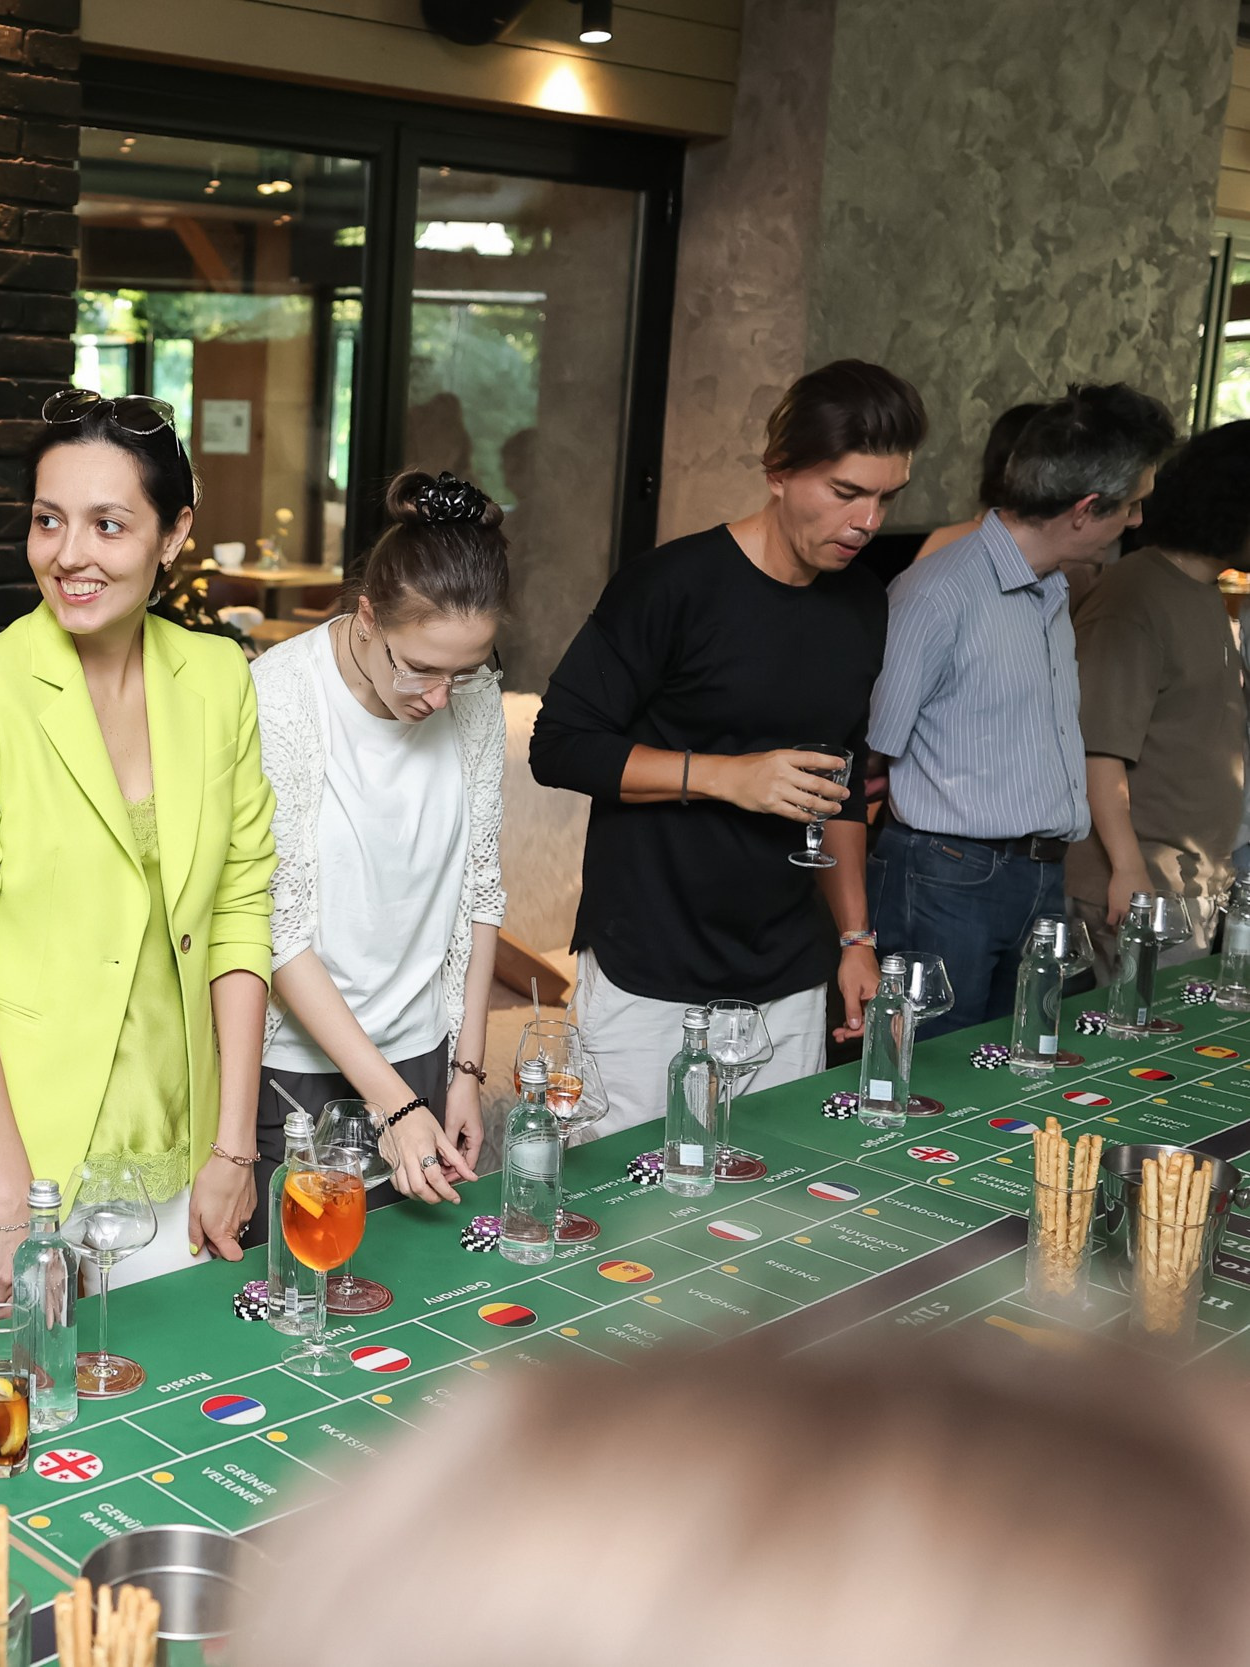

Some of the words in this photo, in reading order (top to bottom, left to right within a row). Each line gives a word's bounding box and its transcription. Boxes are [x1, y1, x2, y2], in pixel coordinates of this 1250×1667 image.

[1138, 1117, 1180, 1131] BLANC
[1143, 1113, 1190, 1128] CHENIN
[763, 1166, 806, 1183] France
[977, 1172, 1032, 1192] GEWÜRZ
[590, 1181, 618, 1193] GAME
[970, 1176, 1027, 1197] RAMINER
[669, 1206, 701, 1218] Italy
[883, 1197, 977, 1230] CHARDONNAY
[829, 1223, 909, 1253] SAUVIGNON
[837, 1234, 885, 1252] BLANC
[555, 1243, 596, 1259] Spain
[765, 1259, 821, 1282] RIESLING
[423, 1281, 491, 1306] Germany
[688, 1288, 750, 1316] VIOGNIER
[156, 1371, 213, 1393] Russia
[201, 1466, 263, 1506] VELTLINER
[223, 1462, 277, 1496] GRÜNER
